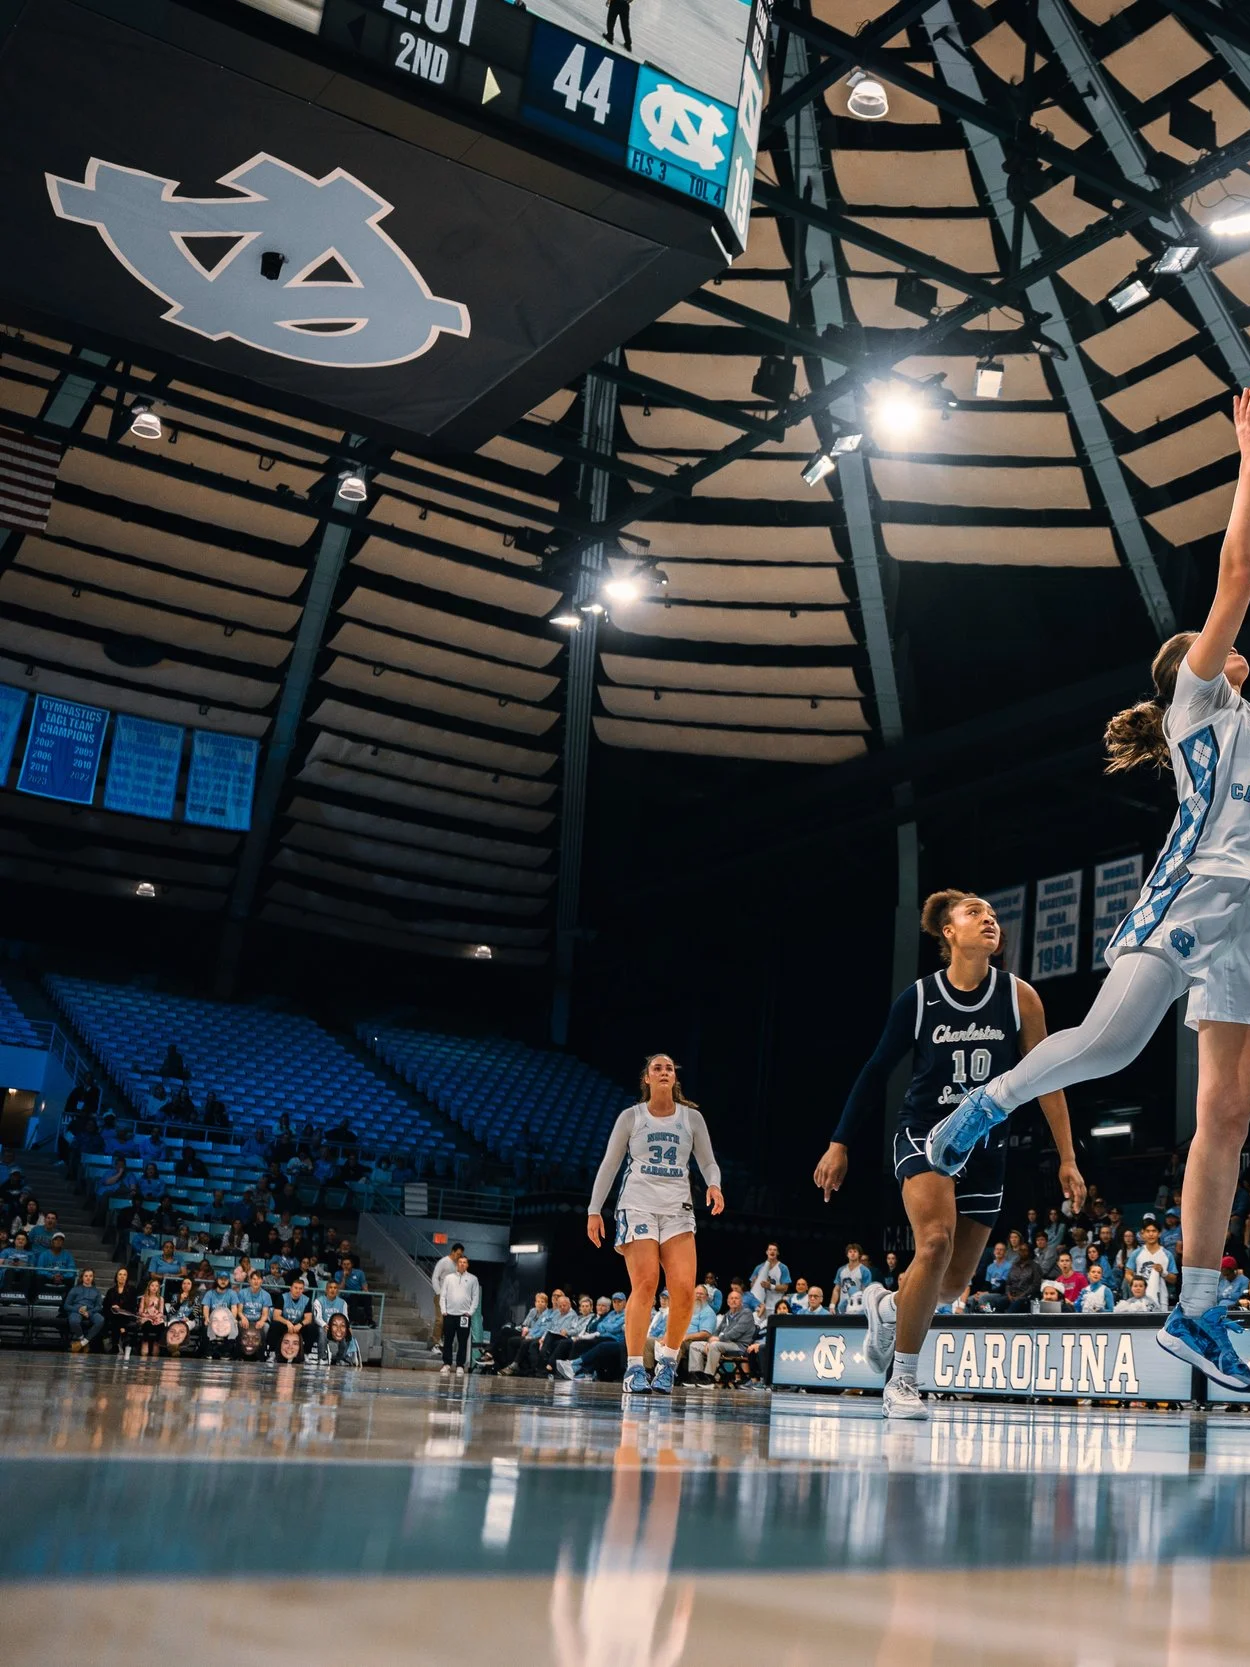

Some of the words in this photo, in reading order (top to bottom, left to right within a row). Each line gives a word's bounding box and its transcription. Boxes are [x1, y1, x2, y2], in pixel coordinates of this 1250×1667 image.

[395, 32, 449, 84] 2ND
[552, 43, 615, 125] 44
[631, 150, 654, 177] FLS
[657, 162, 667, 182] 3
[689, 174, 709, 202] TOL
[713, 186, 723, 206] 4
[731, 156, 749, 235] 19
[42, 699, 102, 722] GYMNASTICS
[39, 722, 95, 745] CHAMPIONS
[69, 718, 94, 733] TEAM
[30, 762, 49, 773] 2011
[932, 1022, 1005, 1044] Charleston
[952, 1049, 992, 1083] 10
[647, 1132, 680, 1145] NORTH
[648, 1145, 678, 1166] 34
[640, 1165, 684, 1178] CAROLINA
[933, 1332, 1140, 1395] CAROLINA
